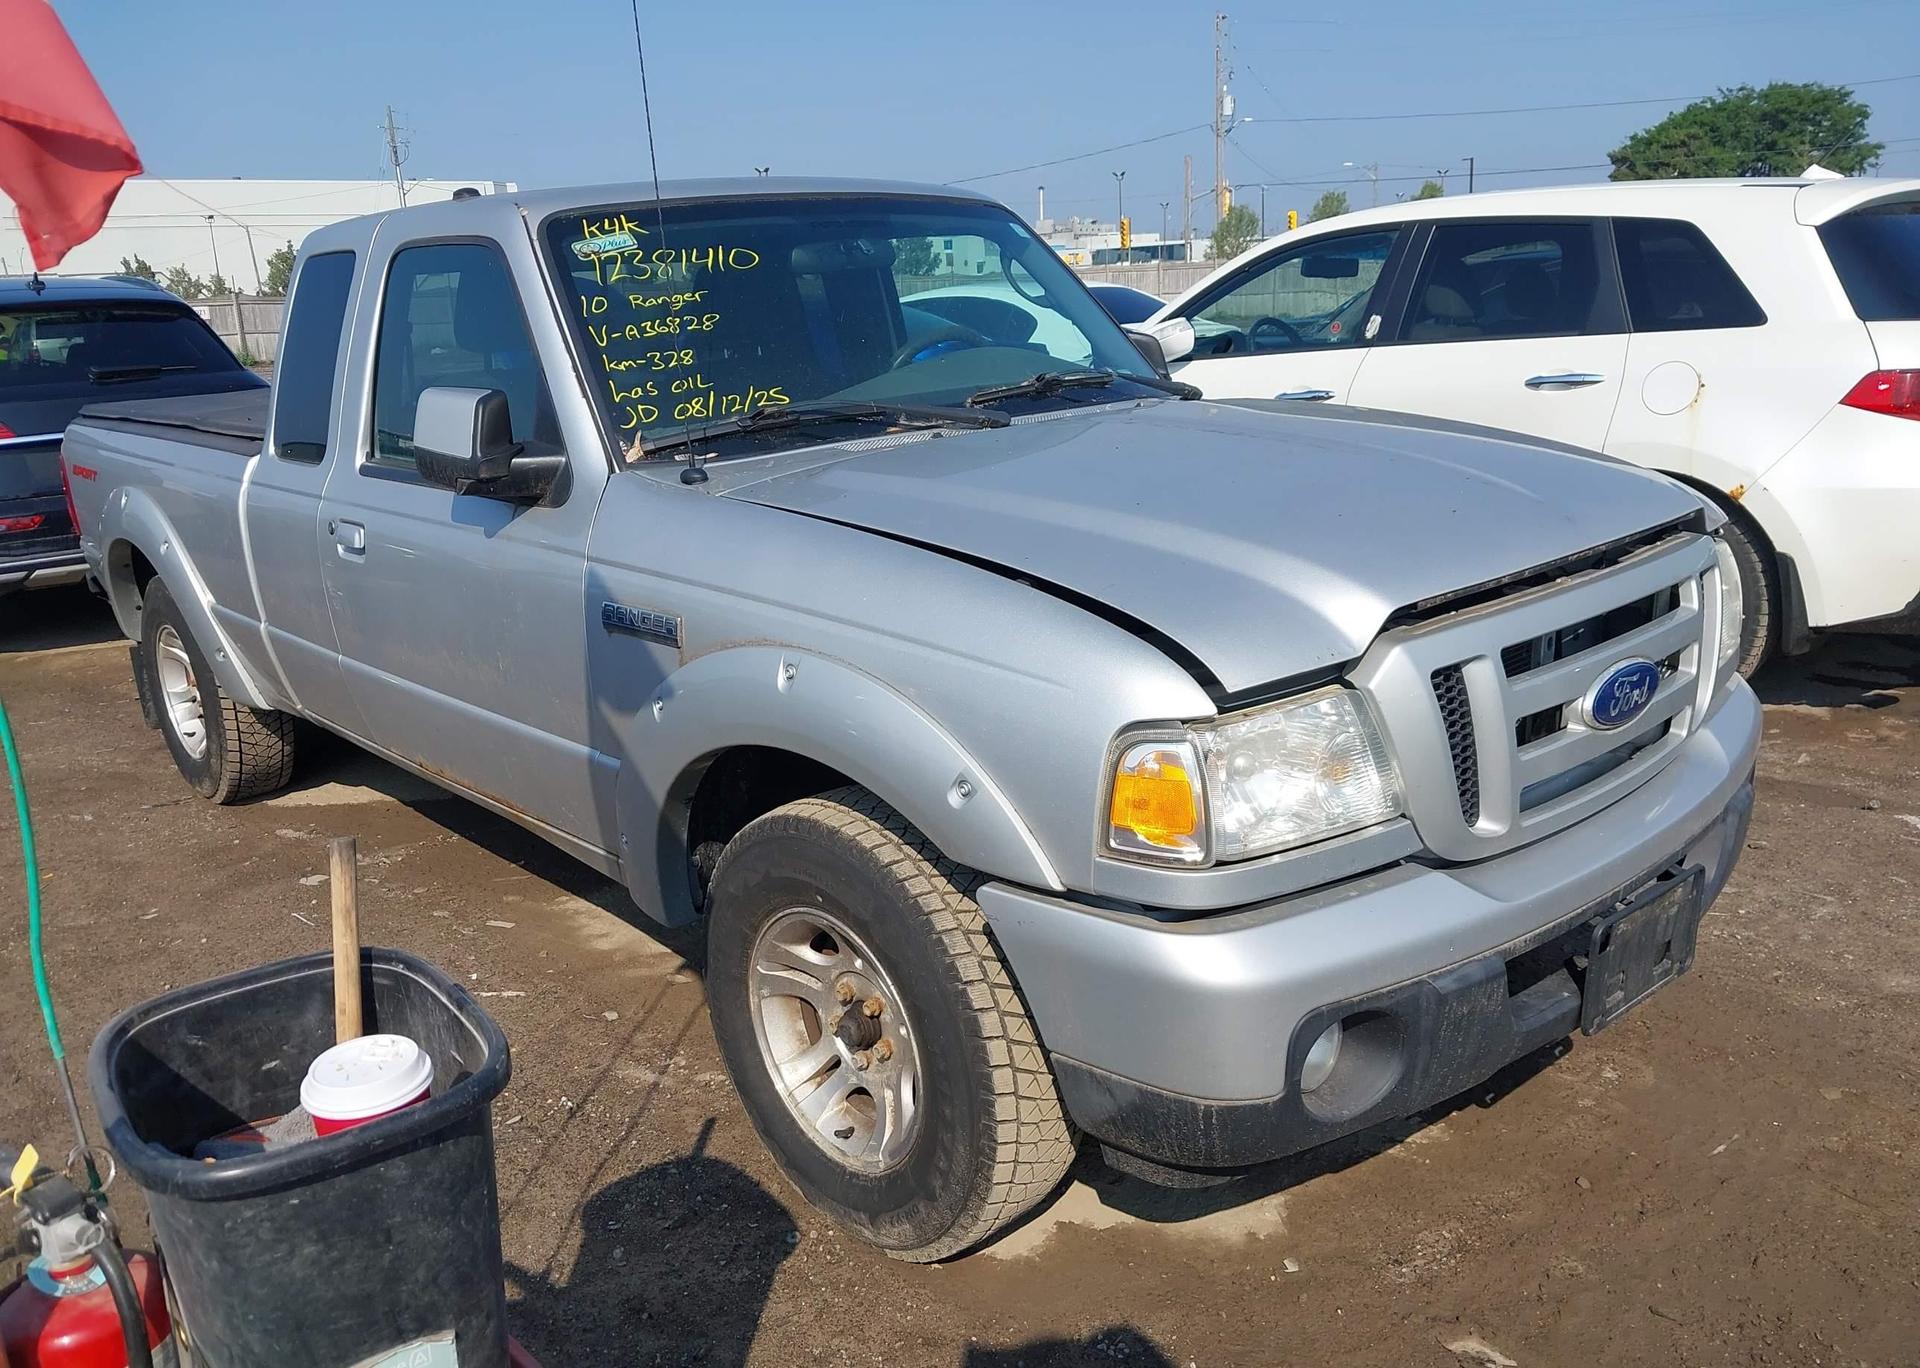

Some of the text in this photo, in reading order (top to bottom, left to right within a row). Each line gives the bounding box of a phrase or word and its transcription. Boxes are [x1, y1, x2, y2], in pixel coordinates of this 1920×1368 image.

[582, 214, 651, 240] K4K
[580, 291, 709, 318] 10 Ranger
[588, 314, 720, 347] V-A36828
[619, 385, 790, 429] JD 08/12/25
[602, 602, 678, 636] RANGER
[1610, 672, 1650, 717] Ford
